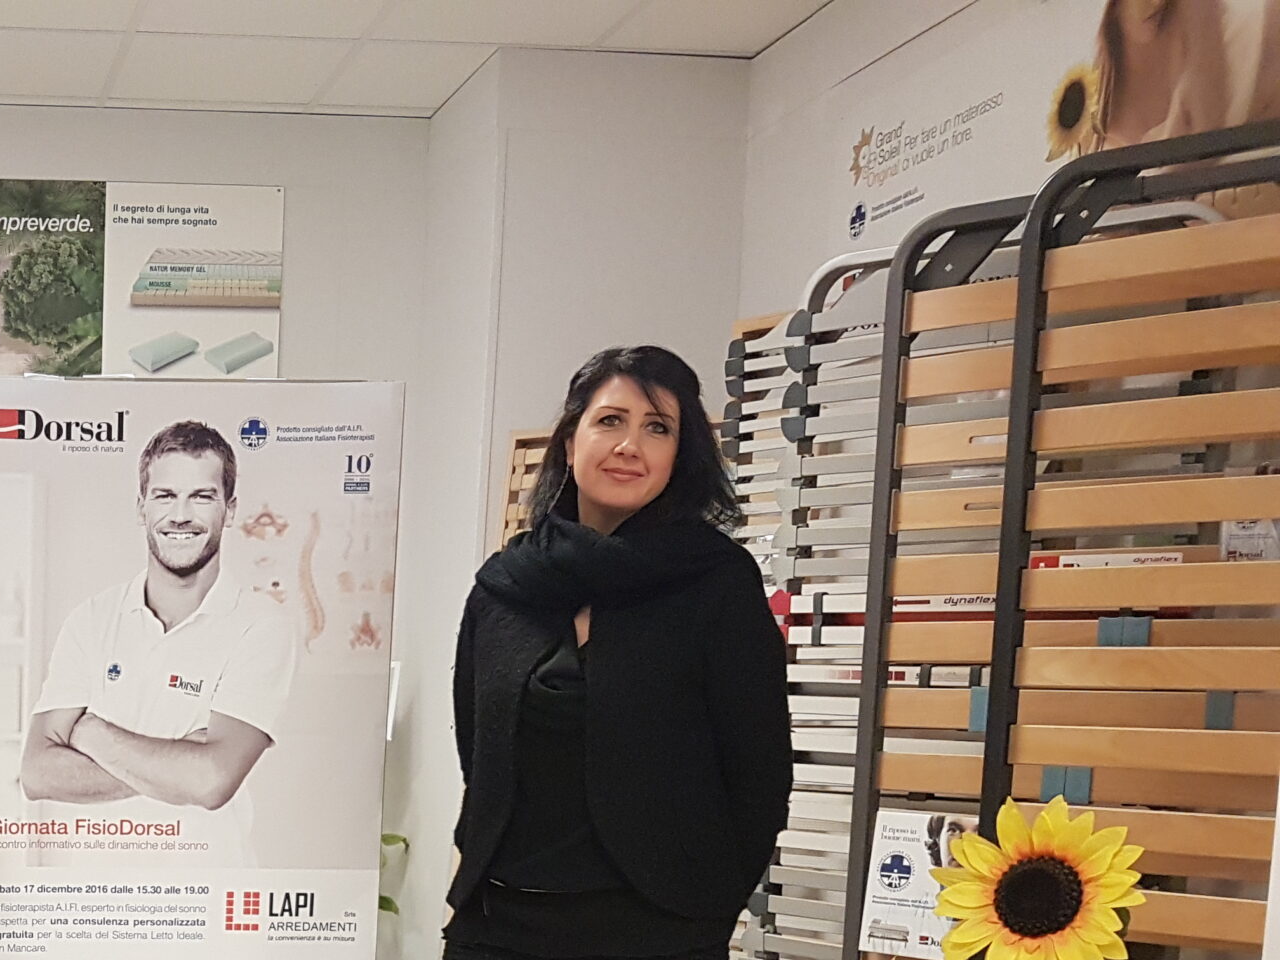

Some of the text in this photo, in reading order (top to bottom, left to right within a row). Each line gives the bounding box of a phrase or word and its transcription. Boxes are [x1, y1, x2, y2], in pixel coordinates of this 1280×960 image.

[904, 134, 918, 151] Per
[940, 118, 952, 135] un
[953, 92, 1004, 128] materasso
[912, 145, 936, 167] vuole
[937, 137, 950, 155] un
[113, 204, 209, 216] Il segreto di lunga vita
[112, 216, 218, 228] che hai sempre sognato
[149, 265, 207, 273] NATUR MEMORY GEL
[17, 409, 125, 442] Dorsal
[302, 425, 334, 434] consigliato
[338, 434, 375, 442] Fisioterapisti
[68, 445, 91, 454] riposo
[92, 444, 99, 452] di
[101, 445, 124, 453] natura
[1133, 556, 1179, 564] dynaflex
[943, 596, 997, 606] dynaflex
[175, 675, 204, 693] Dorsal
[75, 818, 180, 836] FisioDorsal
[29, 839, 82, 849] informativo
[83, 839, 106, 850] sulle
[108, 840, 159, 850] dinamiche
[160, 840, 176, 850] del
[178, 842, 209, 851] sonno
[23, 885, 35, 894] 17
[36, 885, 83, 894] dicembre
[85, 885, 108, 894] 2016
[110, 885, 134, 895] dalle
[137, 885, 162, 895] 15.30
[164, 885, 181, 895] alle
[184, 886, 210, 895] 19.00
[0, 903, 54, 914] fisioterapista
[81, 904, 115, 914] esperto
[125, 903, 163, 915] fisiologia
[164, 904, 178, 913] del
[178, 905, 207, 914] sonno
[268, 892, 315, 917] LAPI
[31, 918, 47, 928] per
[50, 918, 69, 926] una
[72, 917, 130, 927] consulenza
[133, 917, 206, 929] personalizzata
[268, 921, 357, 932] ARREDAMENTI
[37, 932, 52, 941] per
[55, 931, 63, 940] la
[66, 931, 92, 940] scelta
[95, 931, 109, 940] del
[112, 931, 148, 941] Sistema
[150, 931, 174, 941] Letto
[176, 931, 207, 941] Ideale.
[7, 944, 48, 953] Mancare.
